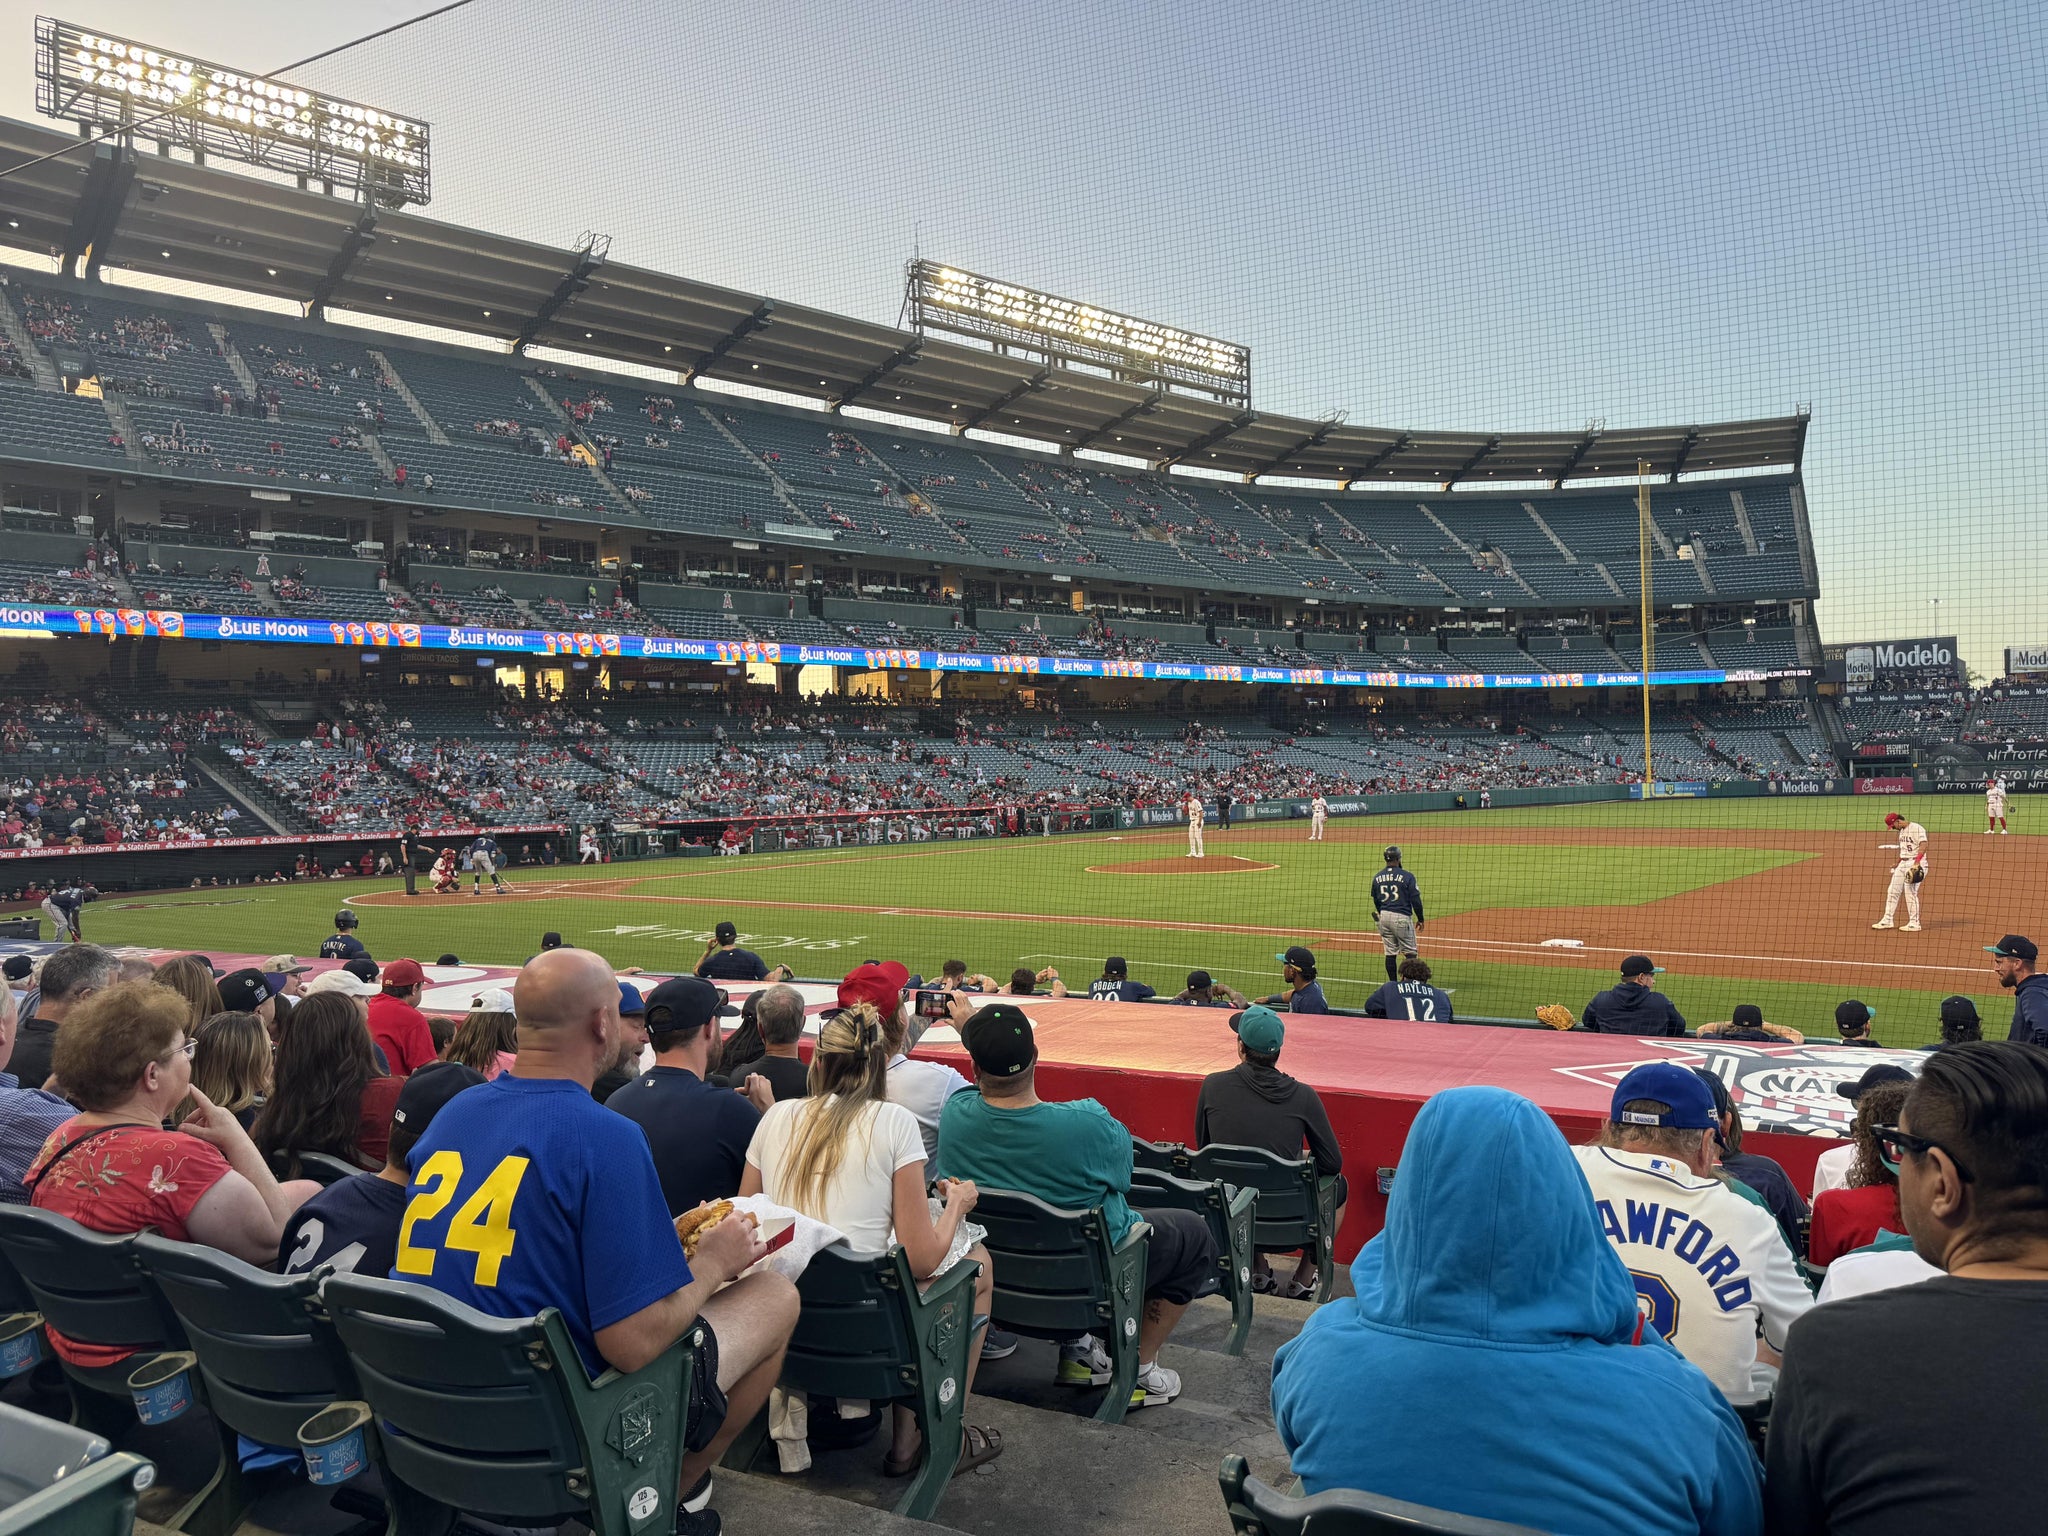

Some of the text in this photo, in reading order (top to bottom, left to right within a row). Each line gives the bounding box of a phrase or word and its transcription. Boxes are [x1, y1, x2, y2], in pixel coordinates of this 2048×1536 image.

[218, 617, 308, 637] BLUE MOON
[448, 628, 524, 646] BLUE MOON
[642, 638, 705, 655] BLUE MOON
[401, 653, 460, 664] CHRONIC TACOS
[799, 646, 852, 662] BLUE MOON
[936, 653, 981, 667] BLUE MOON
[1875, 644, 1951, 668] Modelo
[2018, 651, 2048, 665] Mod
[1053, 659, 1093, 672] BLUE MOON
[1155, 664, 1190, 677] BLUE MOON
[1252, 668, 1283, 680] BLUE MOON
[1333, 671, 1361, 683] BLUE MOON
[1405, 673, 1434, 685] BLUE MOON
[1495, 675, 1511, 686] BLUE
[1596, 674, 1617, 685] BLUE
[1782, 781, 1819, 793] Modelo
[1937, 781, 1966, 789] NITTO
[1257, 806, 1282, 814] FMB.com
[1327, 802, 1360, 813] NETWORK
[1151, 810, 1174, 822] Modelo
[1375, 873, 1404, 883] YOUNG JR.
[1380, 884, 1399, 903] 53
[323, 941, 346, 951] CANZNE
[1397, 983, 1433, 996] NAYLOR
[1403, 997, 1436, 1021] 12
[1760, 1074, 1838, 1094] NAT
[396, 1151, 530, 1287] 24
[1596, 1198, 1752, 1312] AWFORD
[637, 1489, 648, 1502] 125
